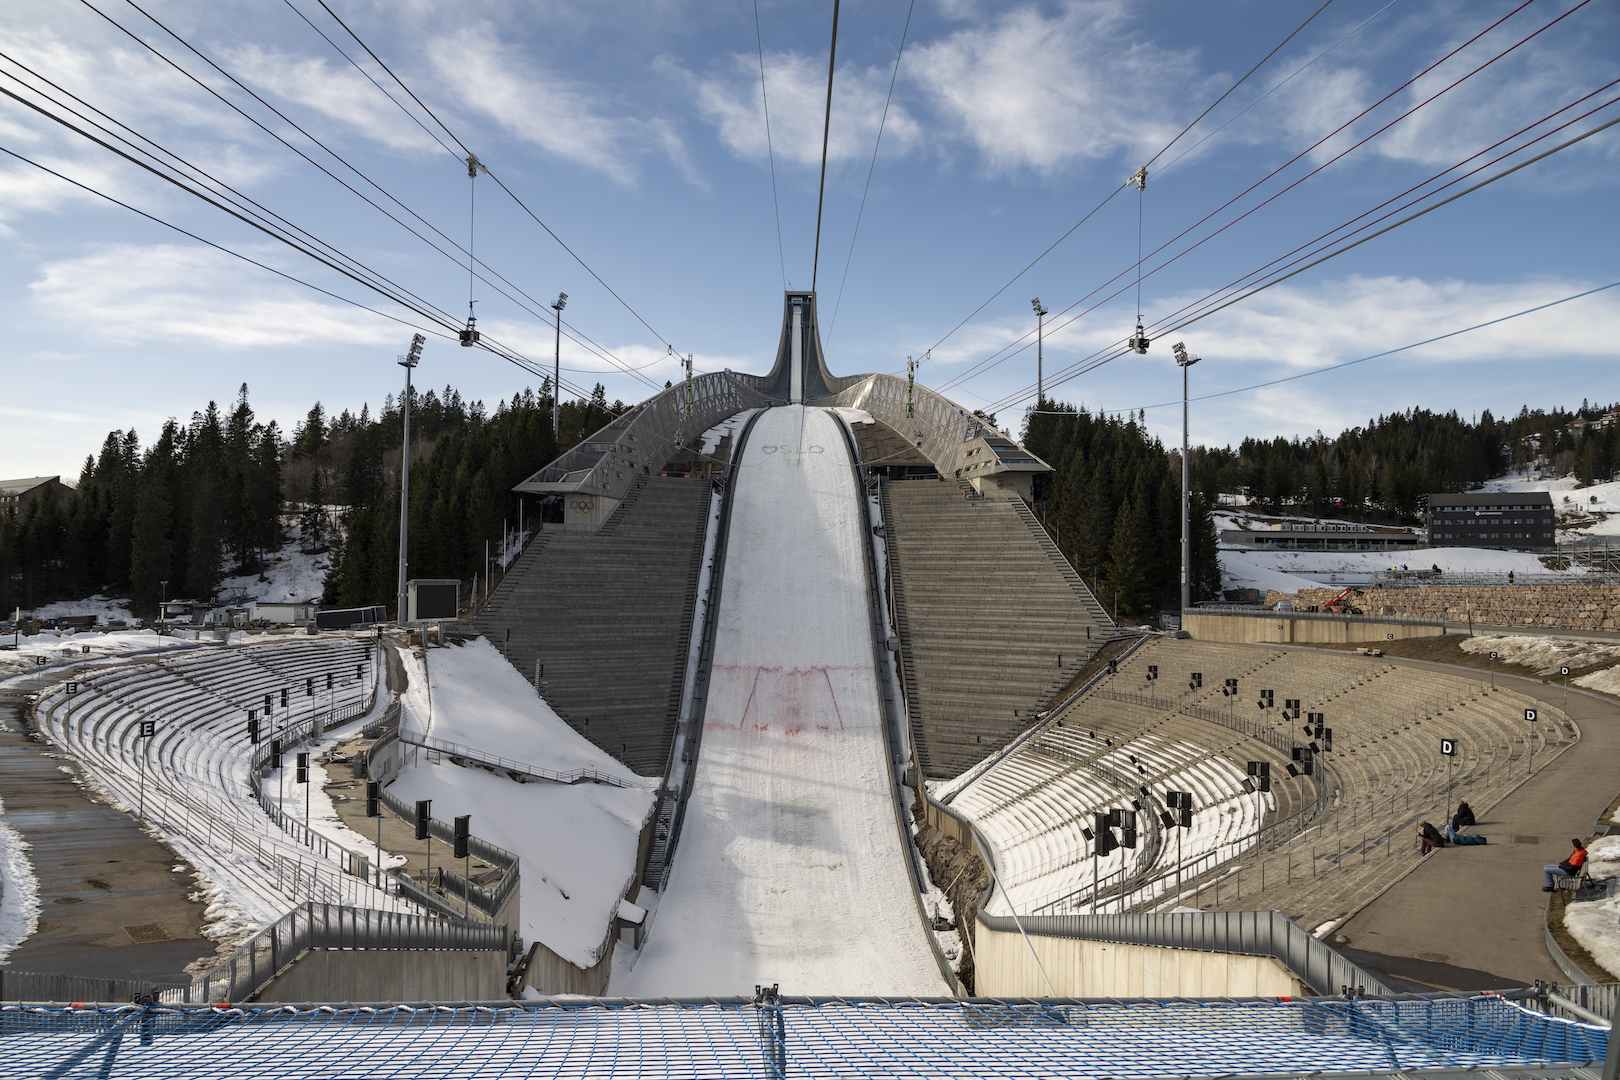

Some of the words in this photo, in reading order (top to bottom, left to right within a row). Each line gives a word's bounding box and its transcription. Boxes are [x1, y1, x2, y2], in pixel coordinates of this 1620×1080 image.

[68, 683, 75, 692] E
[1526, 710, 1535, 720] D
[143, 722, 152, 735] E
[1442, 740, 1452, 753] D
